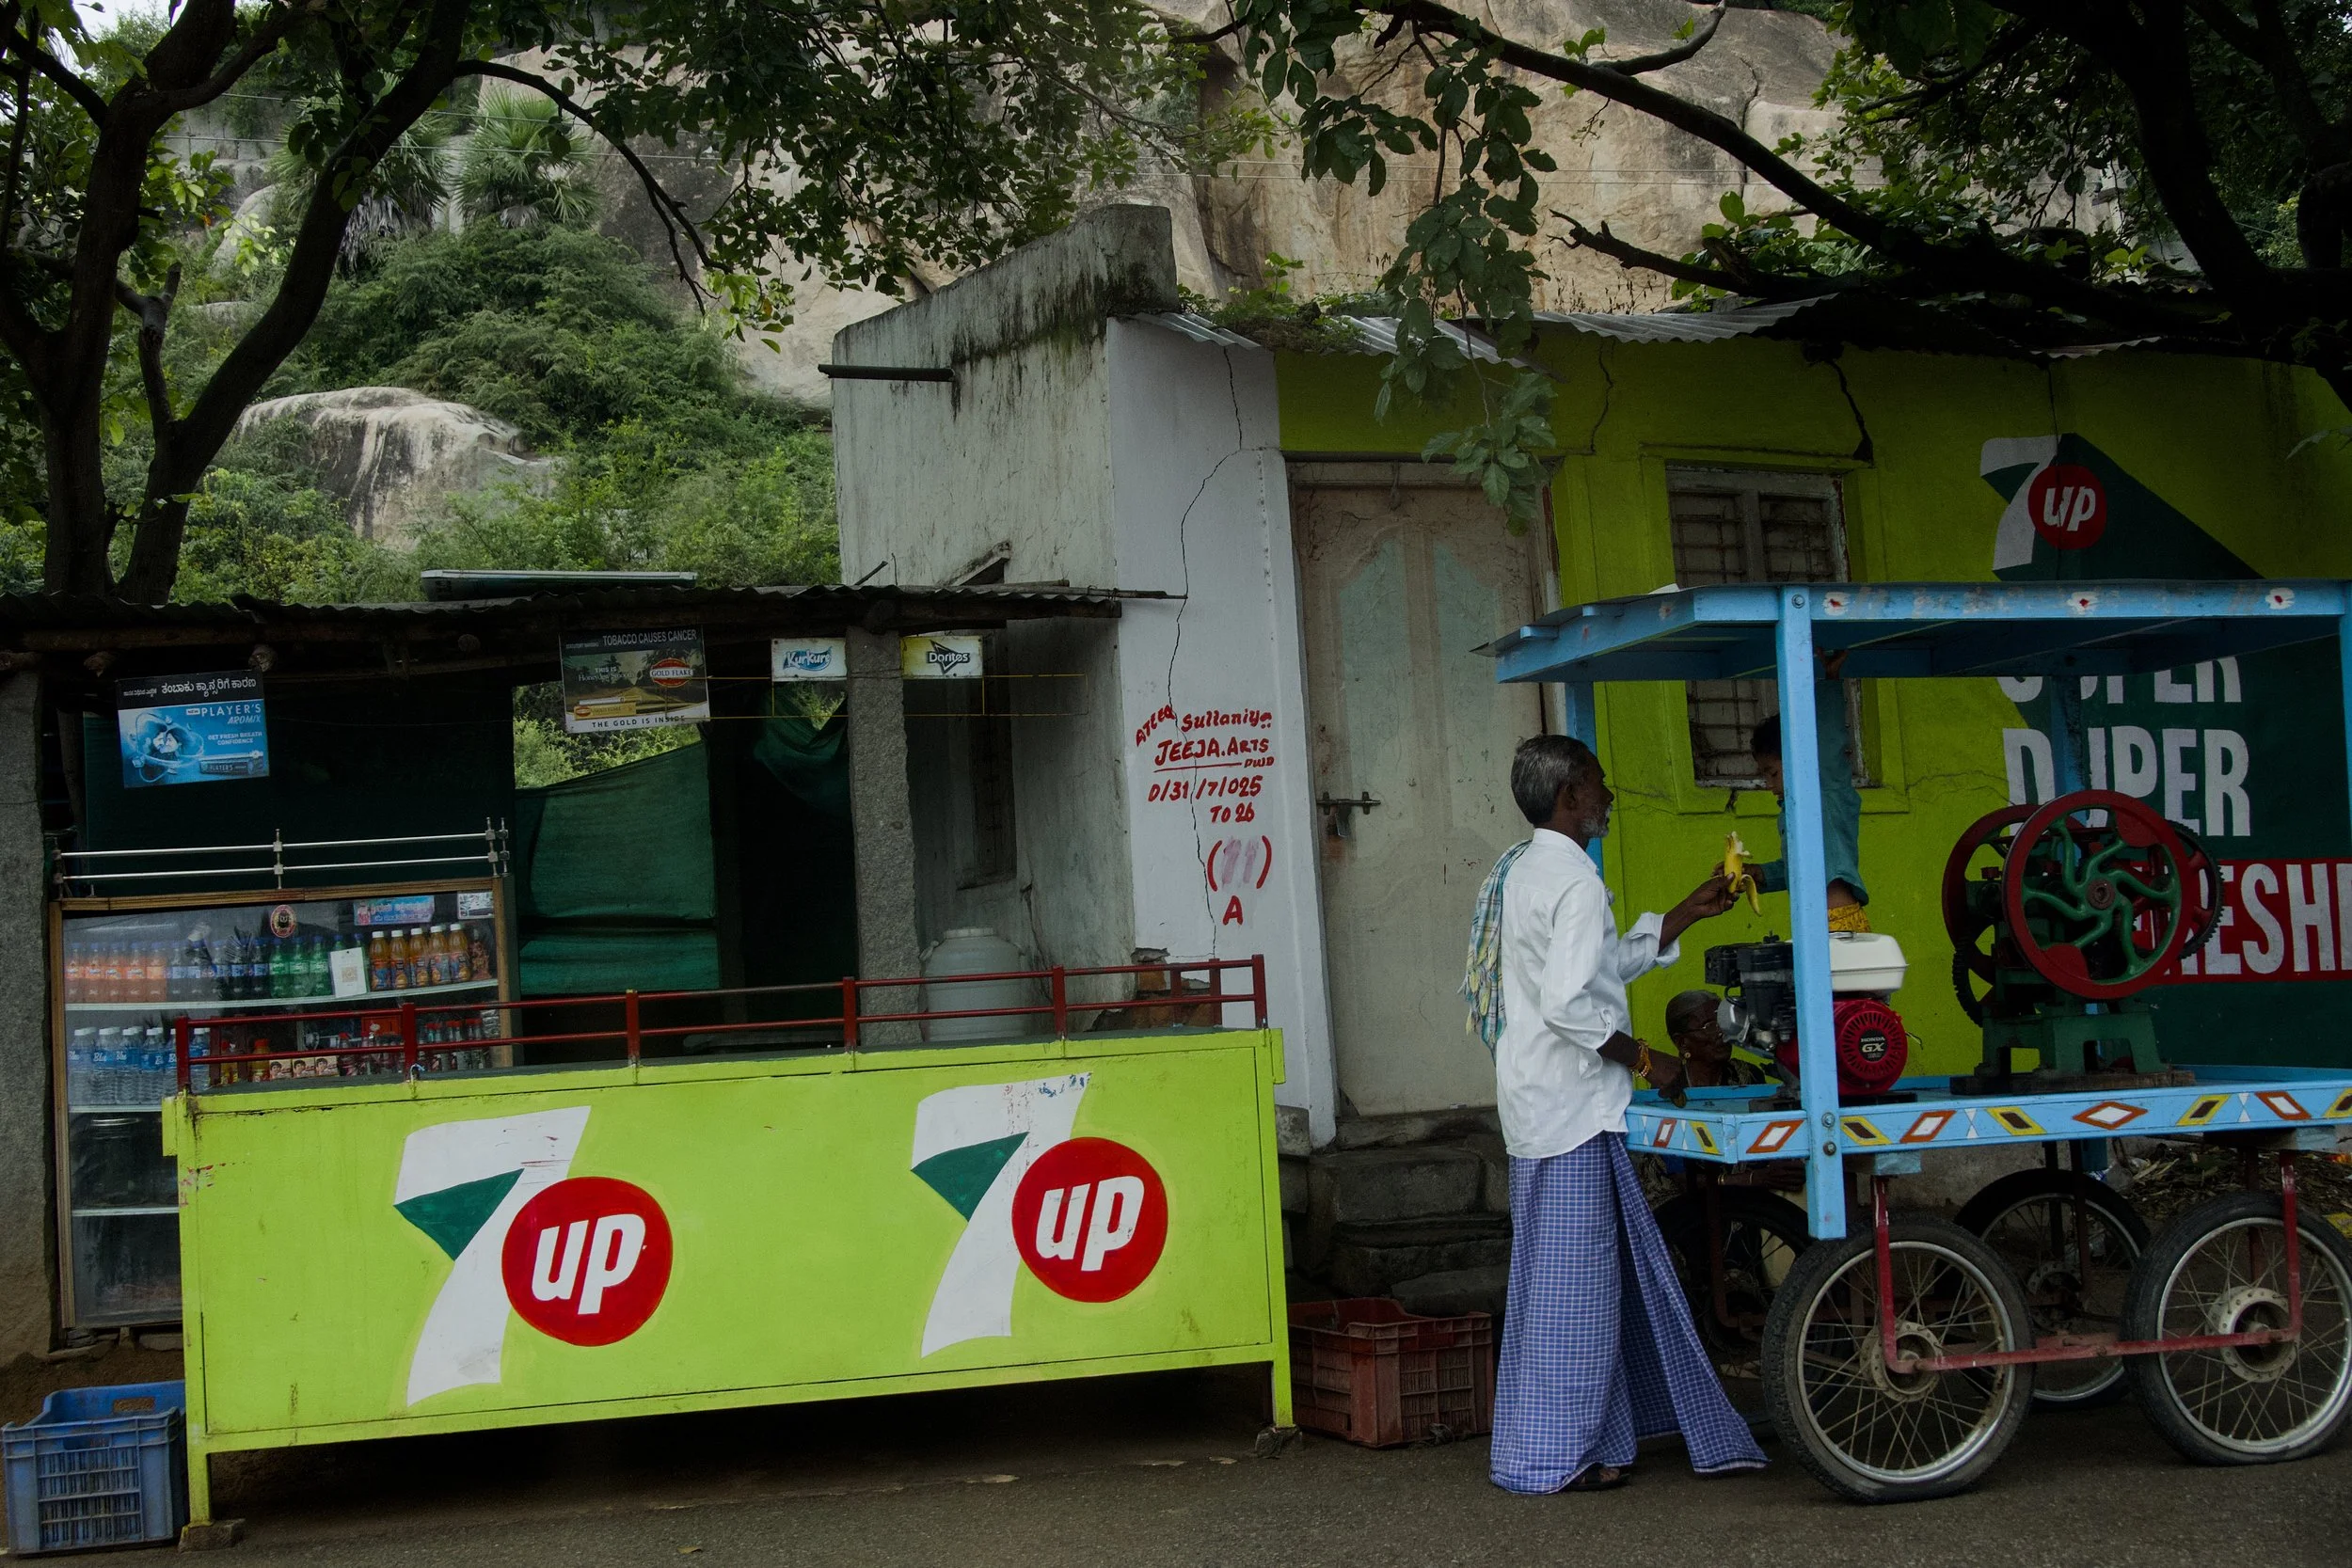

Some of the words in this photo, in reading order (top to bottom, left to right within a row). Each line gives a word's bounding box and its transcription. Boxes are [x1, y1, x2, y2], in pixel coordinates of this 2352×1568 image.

[603, 633, 638, 646] TOBACCO
[638, 631, 667, 643] CAUSES
[667, 629, 697, 641] CANCER
[786, 650, 832, 665] Kurkure
[929, 652, 968, 663] Doritos
[651, 669, 671, 677] GOLD
[201, 704, 262, 717] PLAYER'S
[227, 715, 262, 724] AROMIX
[613, 719, 637, 727] GOLD
[655, 715, 685, 723] INSIDE
[1210, 805, 1232, 824] TO
[1234, 801, 1255, 823] 26
[1222, 895, 1243, 926] A
[1862, 1042, 1884, 1053] GX
